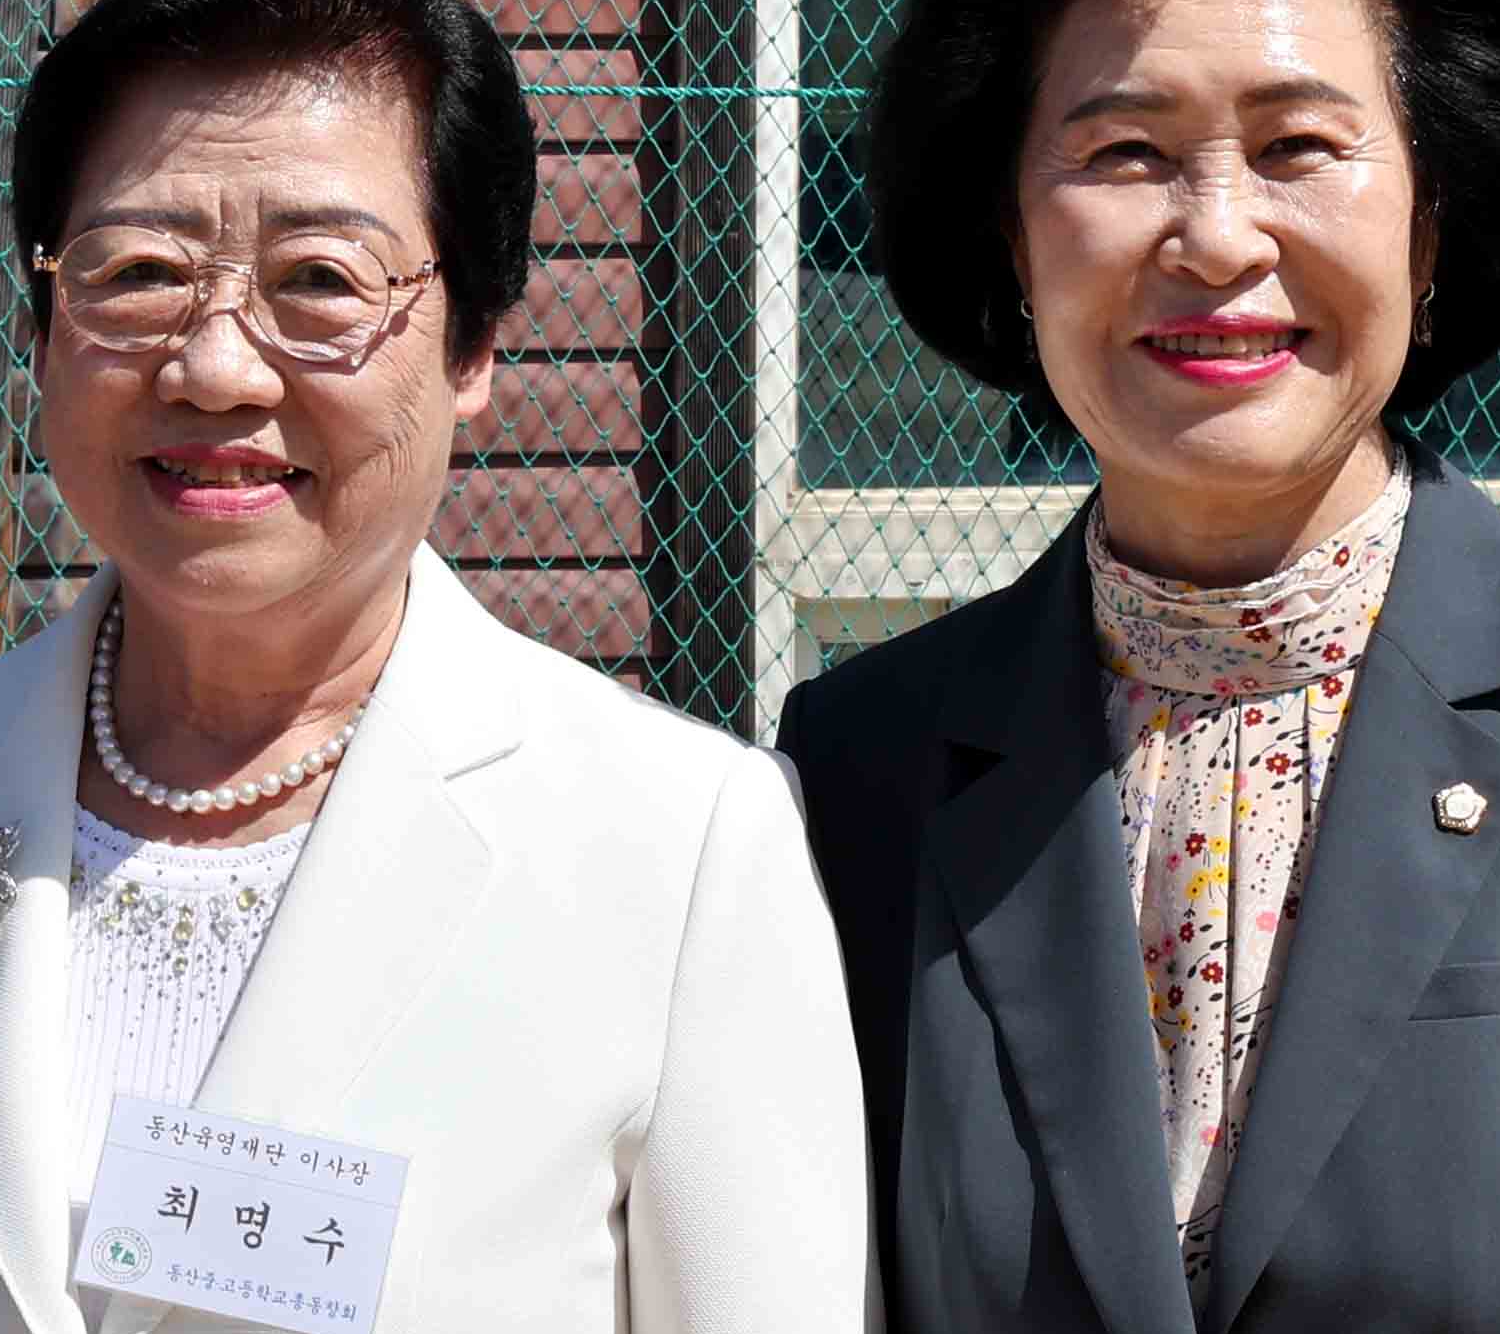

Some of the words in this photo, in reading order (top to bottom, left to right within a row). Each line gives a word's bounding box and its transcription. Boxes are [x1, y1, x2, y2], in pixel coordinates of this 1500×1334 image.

[144, 1114, 287, 1168] 동산육영재단
[299, 1149, 371, 1187] 이사장
[156, 1183, 345, 1267] 최명수
